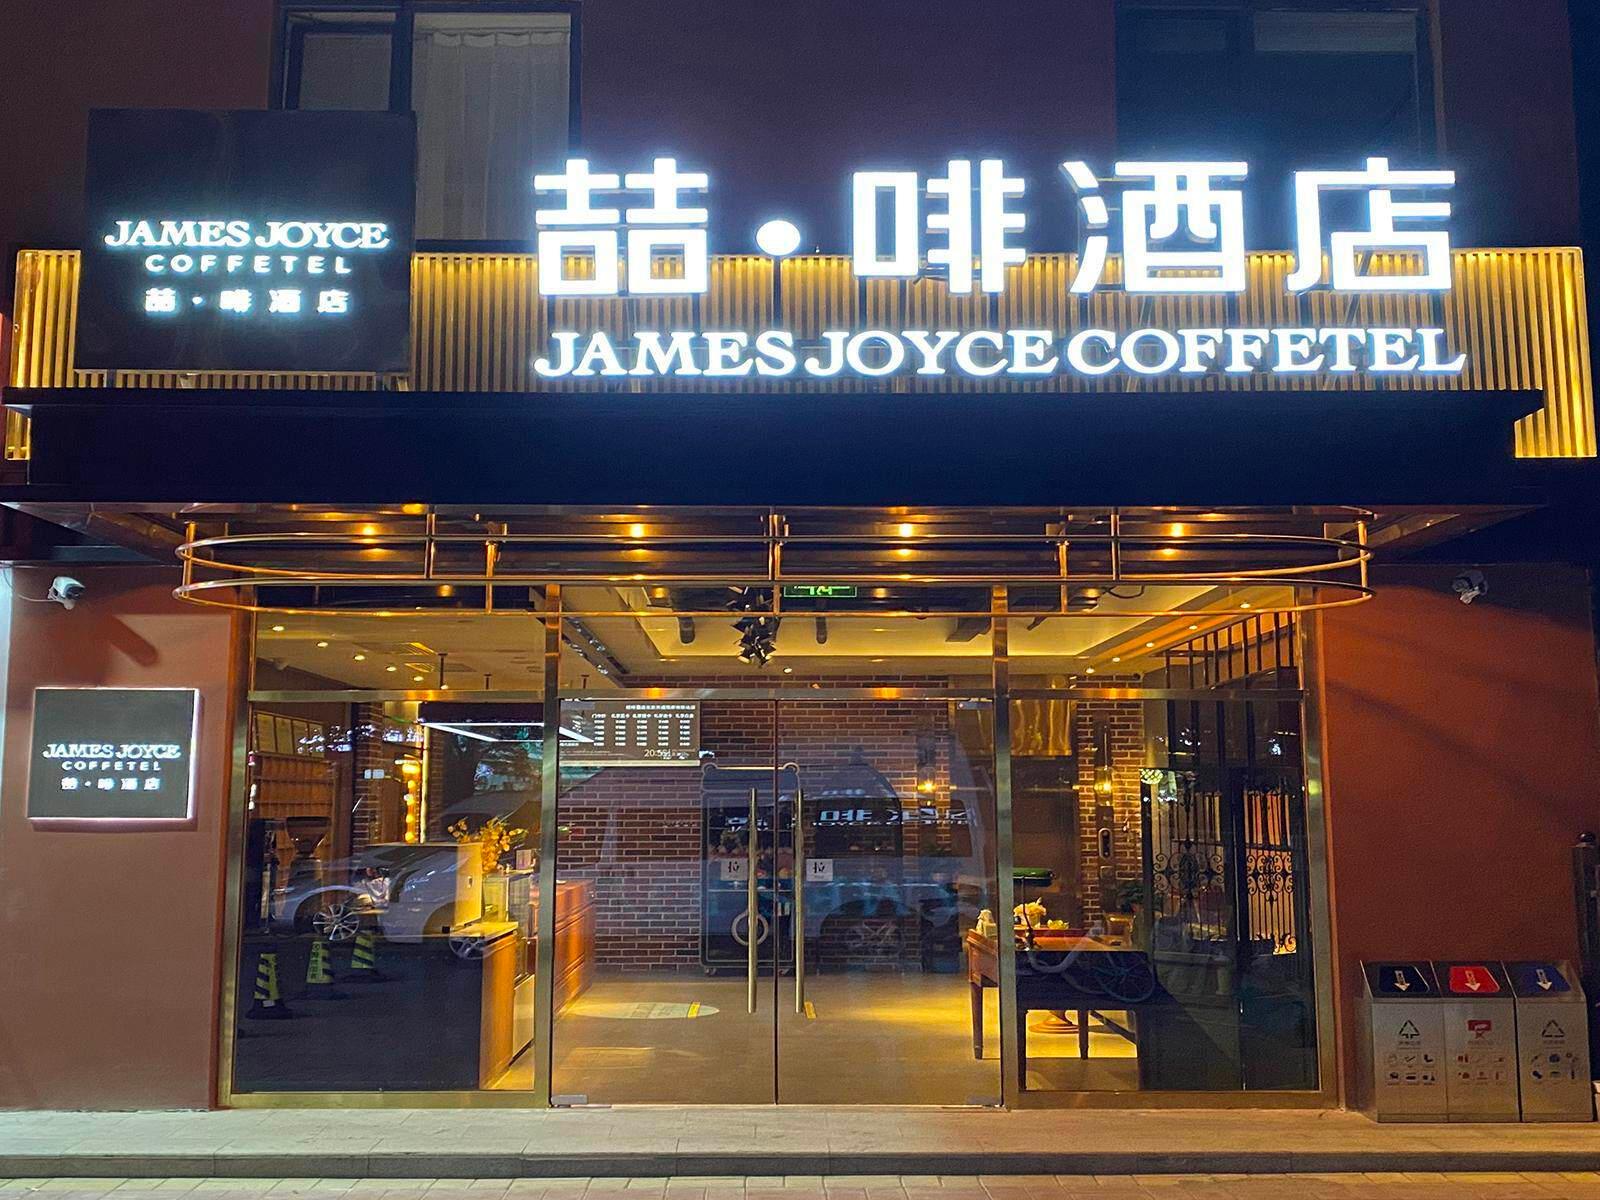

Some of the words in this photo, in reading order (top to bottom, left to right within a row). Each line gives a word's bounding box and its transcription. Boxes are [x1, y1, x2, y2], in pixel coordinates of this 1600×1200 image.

[104, 220, 251, 247] JAMES
[255, 221, 390, 249] JOYCE
[145, 254, 351, 274] COFFETEL
[534, 330, 796, 378] JAMES
[804, 329, 1059, 377] JOYCE
[1067, 327, 1467, 377] COFFETEL
[42, 743, 114, 759] JAMES
[115, 743, 182, 759] JOYCE
[61, 761, 162, 771] COFFETEL
